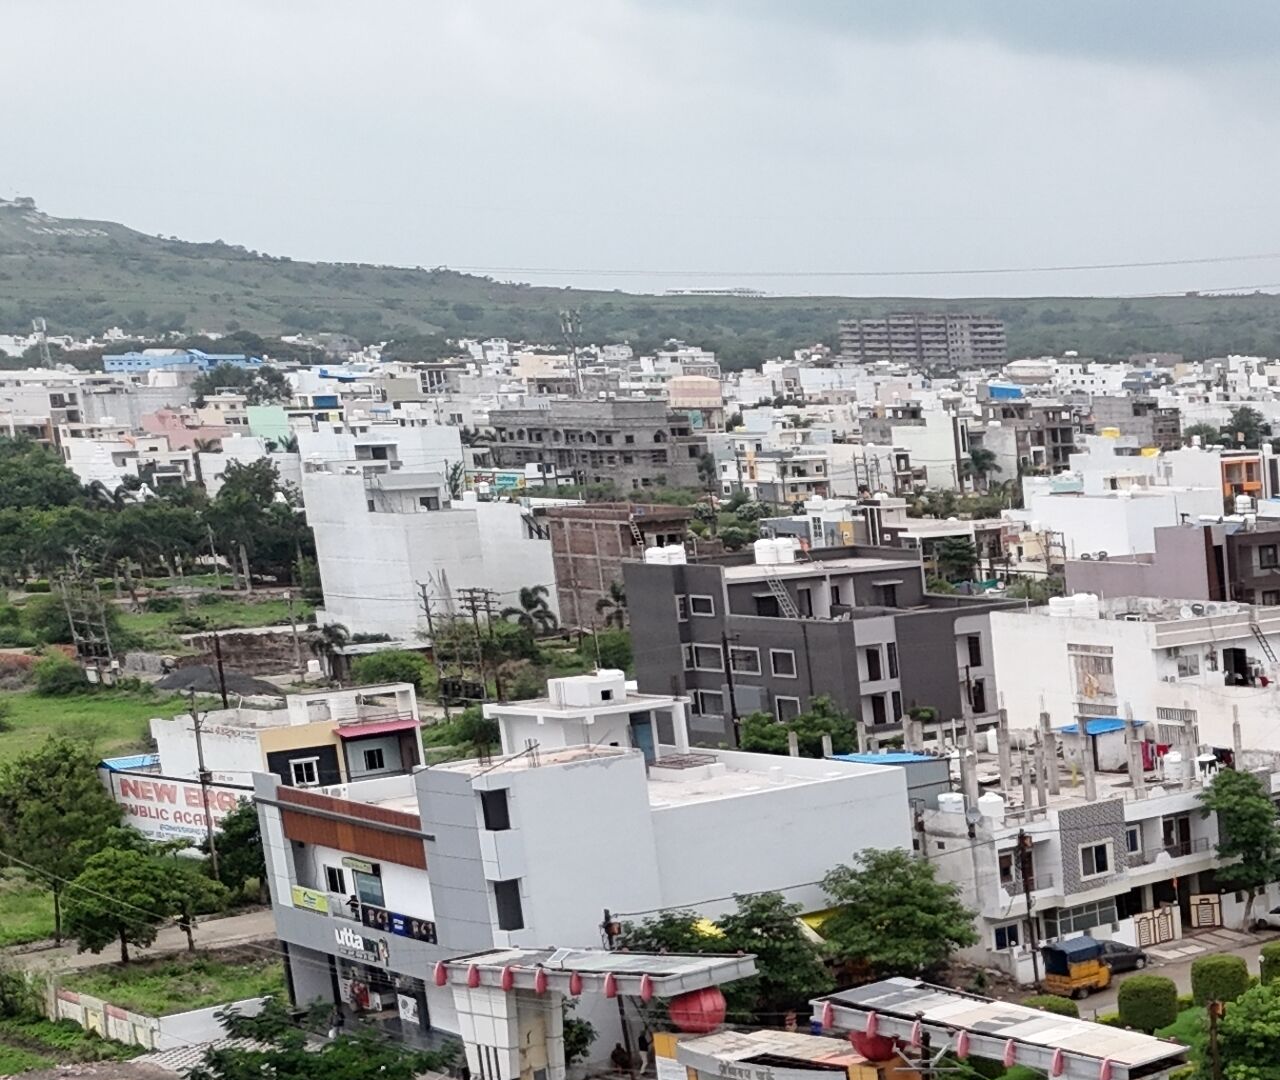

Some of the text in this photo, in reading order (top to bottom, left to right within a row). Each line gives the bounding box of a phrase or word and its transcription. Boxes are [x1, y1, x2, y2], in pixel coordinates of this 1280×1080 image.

[119, 777, 178, 805] NEW
[121, 802, 221, 829] PUBLIC ACADE
